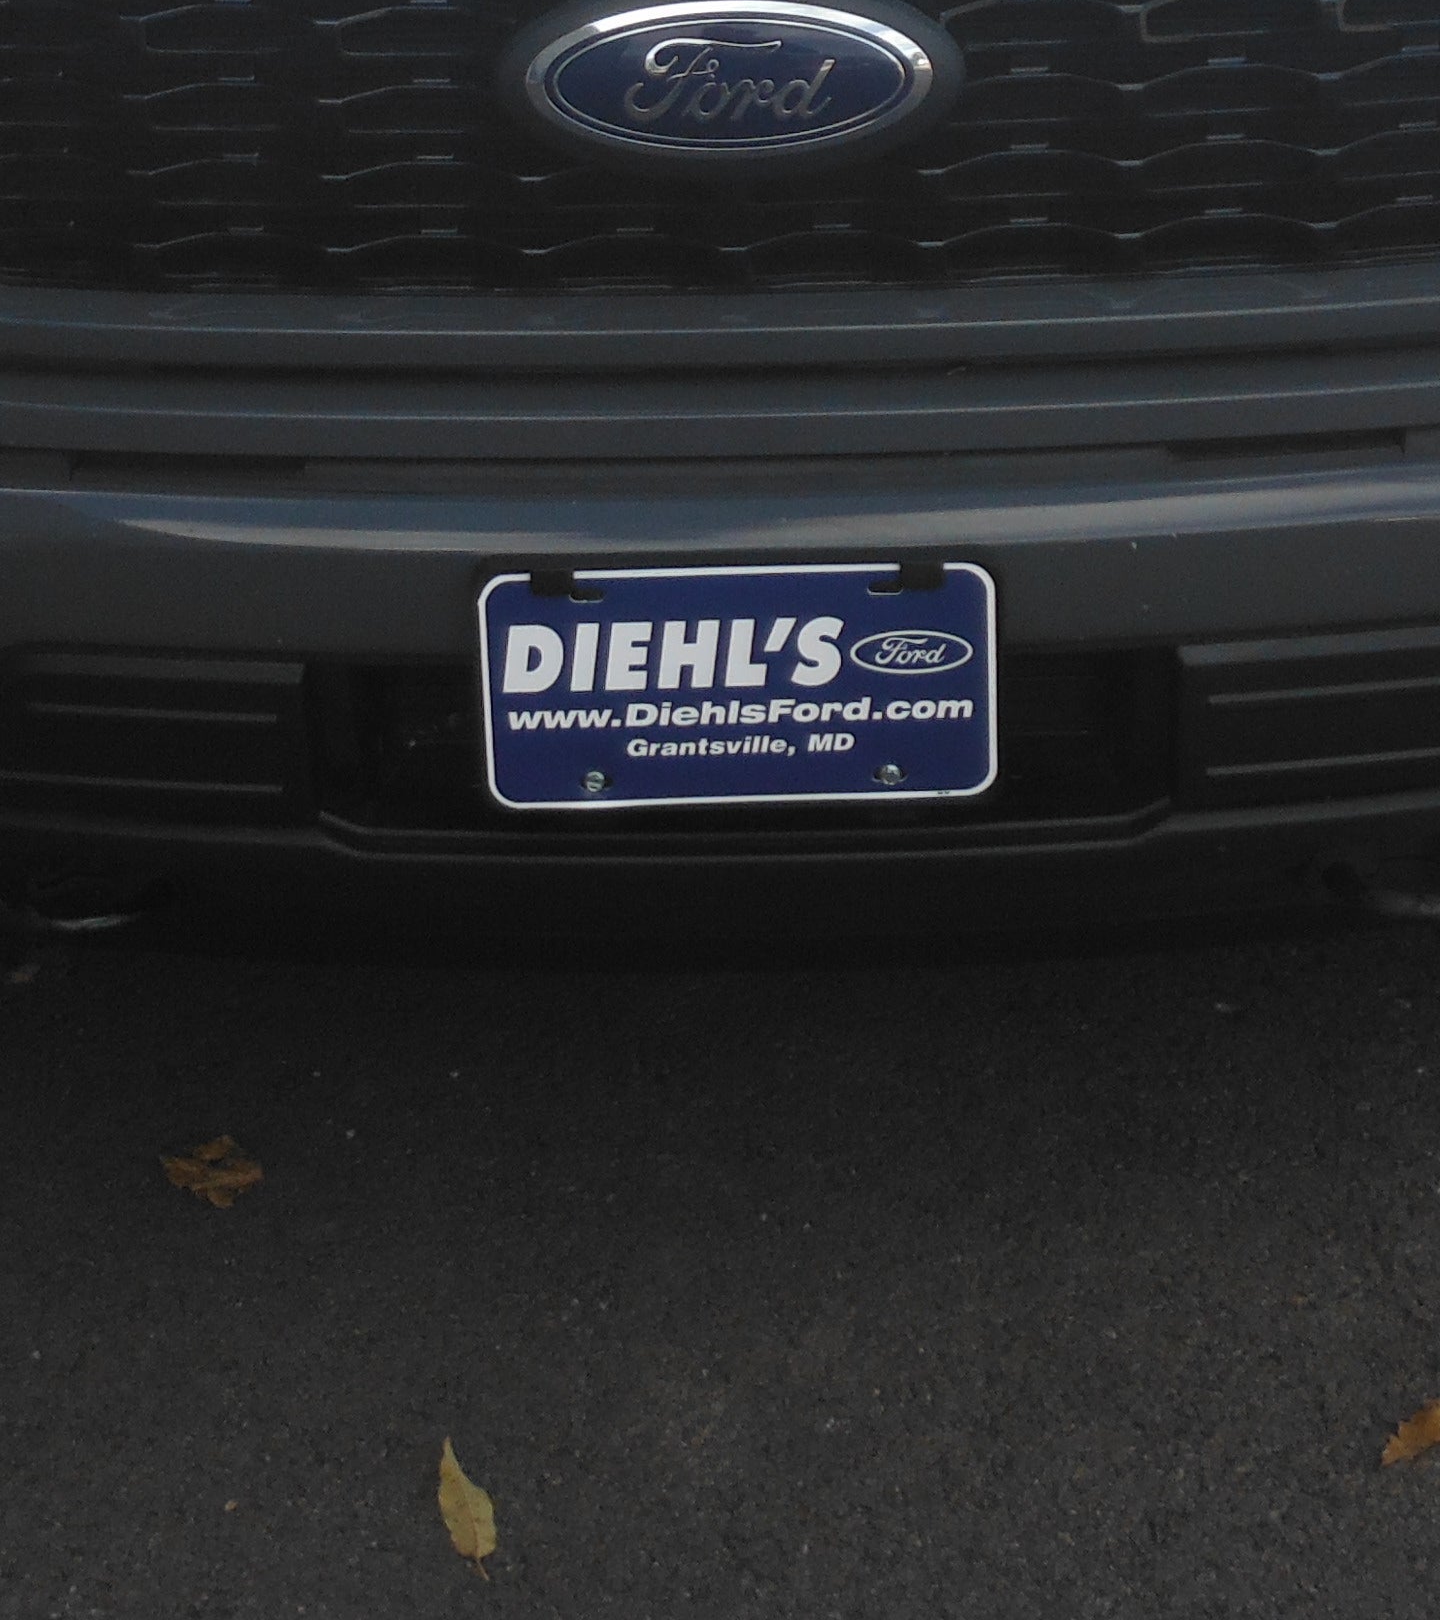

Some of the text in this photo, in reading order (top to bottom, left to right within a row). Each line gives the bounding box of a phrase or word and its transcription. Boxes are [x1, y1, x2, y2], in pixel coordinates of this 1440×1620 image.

[623, 37, 836, 121] Ford
[503, 616, 946, 694] DIEHL'S Ford
[508, 696, 974, 730] www.DiehlsFord.com
[626, 732, 856, 758] Grantsville, MD
